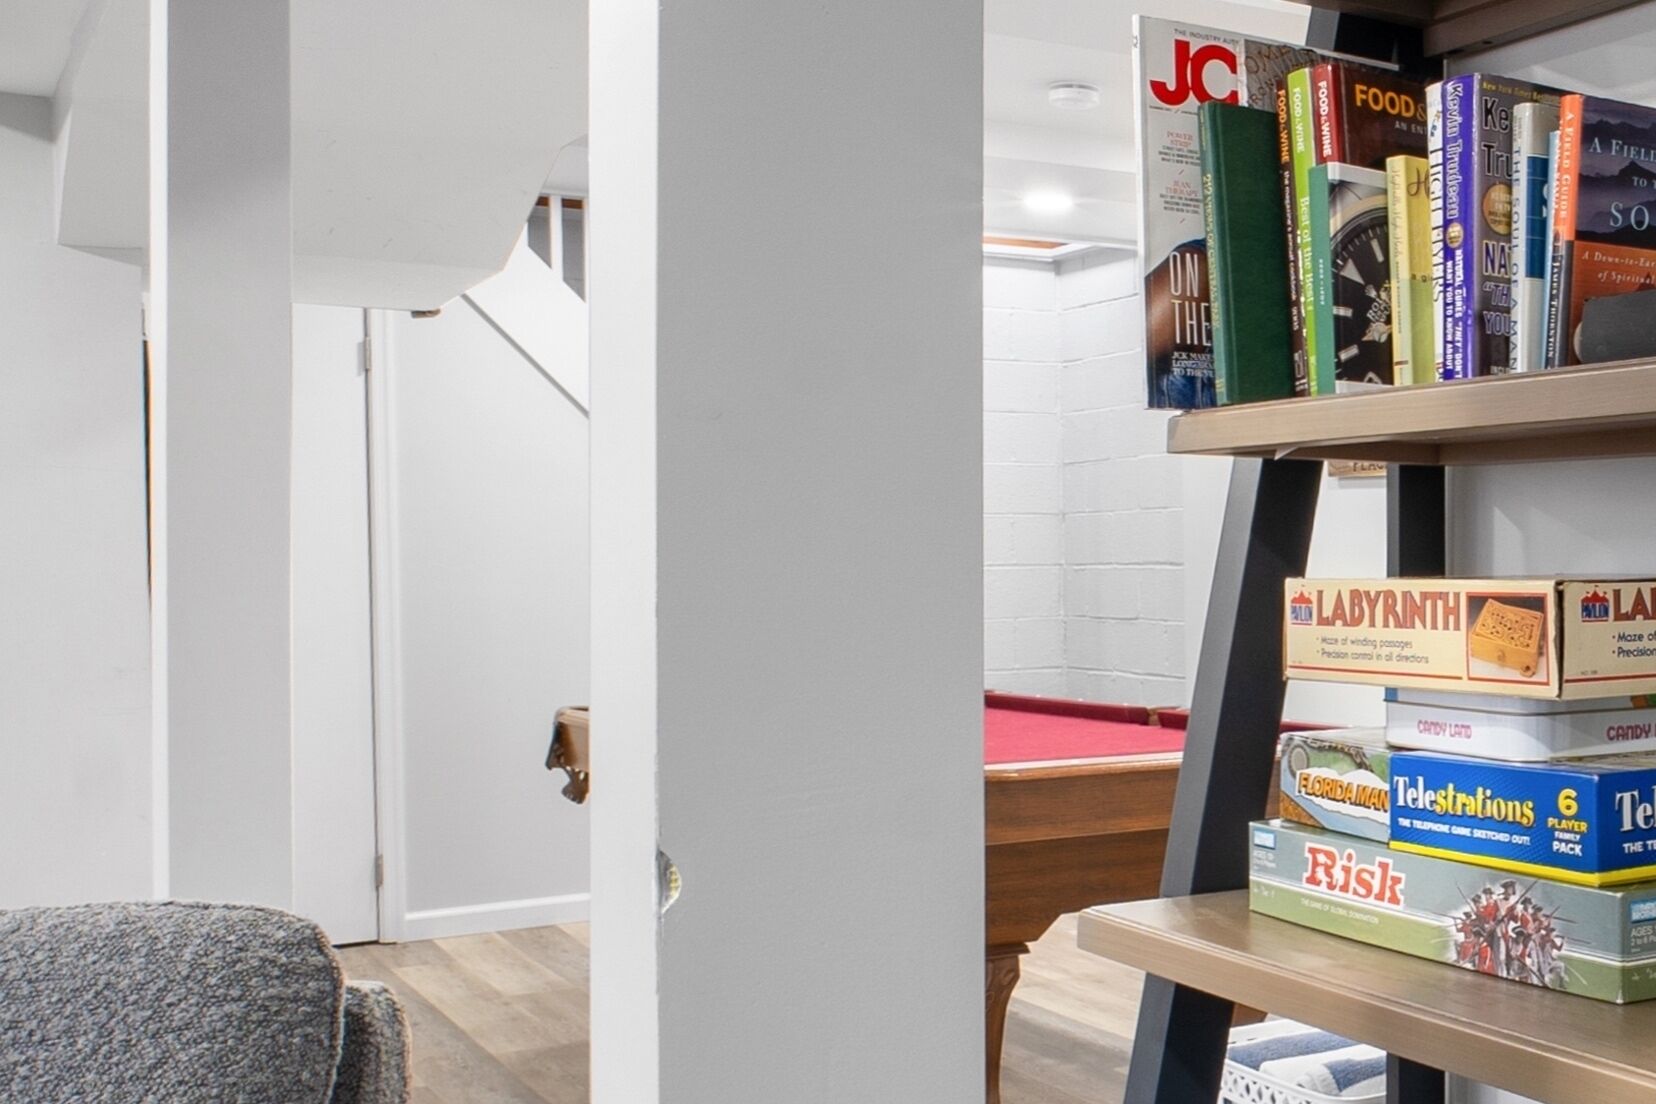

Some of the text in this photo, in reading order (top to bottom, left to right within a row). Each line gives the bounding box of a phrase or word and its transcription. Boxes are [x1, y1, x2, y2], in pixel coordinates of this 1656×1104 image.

[1174, 28, 1221, 43] THE INDUSTRY
[1150, 39, 1240, 106] JC
[1355, 84, 1415, 118] FOOD
[1446, 81, 1463, 137] Kevin
[1394, 121, 1408, 131] AN
[1563, 128, 1574, 168] FIELD
[1589, 137, 1601, 153] A
[1512, 147, 1521, 186] THE
[1202, 173, 1212, 195] 212
[1446, 140, 1463, 219] Trudeau
[1632, 176, 1648, 188] TO
[1560, 175, 1572, 218] GUIDE
[1300, 196, 1310, 230] Best
[1511, 197, 1521, 250] SOUL
[1303, 232, 1311, 243] of
[1304, 249, 1313, 271] the
[1582, 251, 1589, 260] A
[1169, 251, 1199, 298] ON
[1446, 261, 1454, 284] WANT
[1455, 249, 1464, 285] NATURAL
[1597, 271, 1608, 280] of
[1611, 270, 1655, 285] Spiritual
[1446, 286, 1454, 303] YOU
[1446, 305, 1453, 316] TO
[1547, 262, 1561, 358] JAMES THORNTON
[1171, 299, 1213, 347] THE
[1445, 343, 1453, 369] ABOUT
[1316, 588, 1461, 631] LABYRINTH
[1321, 636, 1413, 651] Maze of winding passages
[1617, 631, 1644, 643] Maze
[1647, 630, 1656, 642] of
[1321, 648, 1430, 664] Precision control in all directions
[1617, 646, 1656, 659] Precision
[1417, 719, 1472, 739] CANDY LAND
[1606, 724, 1650, 741] CANDY
[1299, 772, 1389, 813] FLORIDA MAN
[1393, 775, 1535, 827] Telestrations
[1557, 788, 1579, 817] 6
[1398, 818, 1531, 846] THE TELEPHONE GAME SKETCHED OUT!
[1547, 817, 1588, 833] PLAYER
[1554, 830, 1581, 842] FAMILY
[1552, 840, 1582, 857] PACK
[1623, 839, 1644, 854] THE
[1304, 845, 1403, 906] Risk
[1631, 926, 1653, 938] AGES
